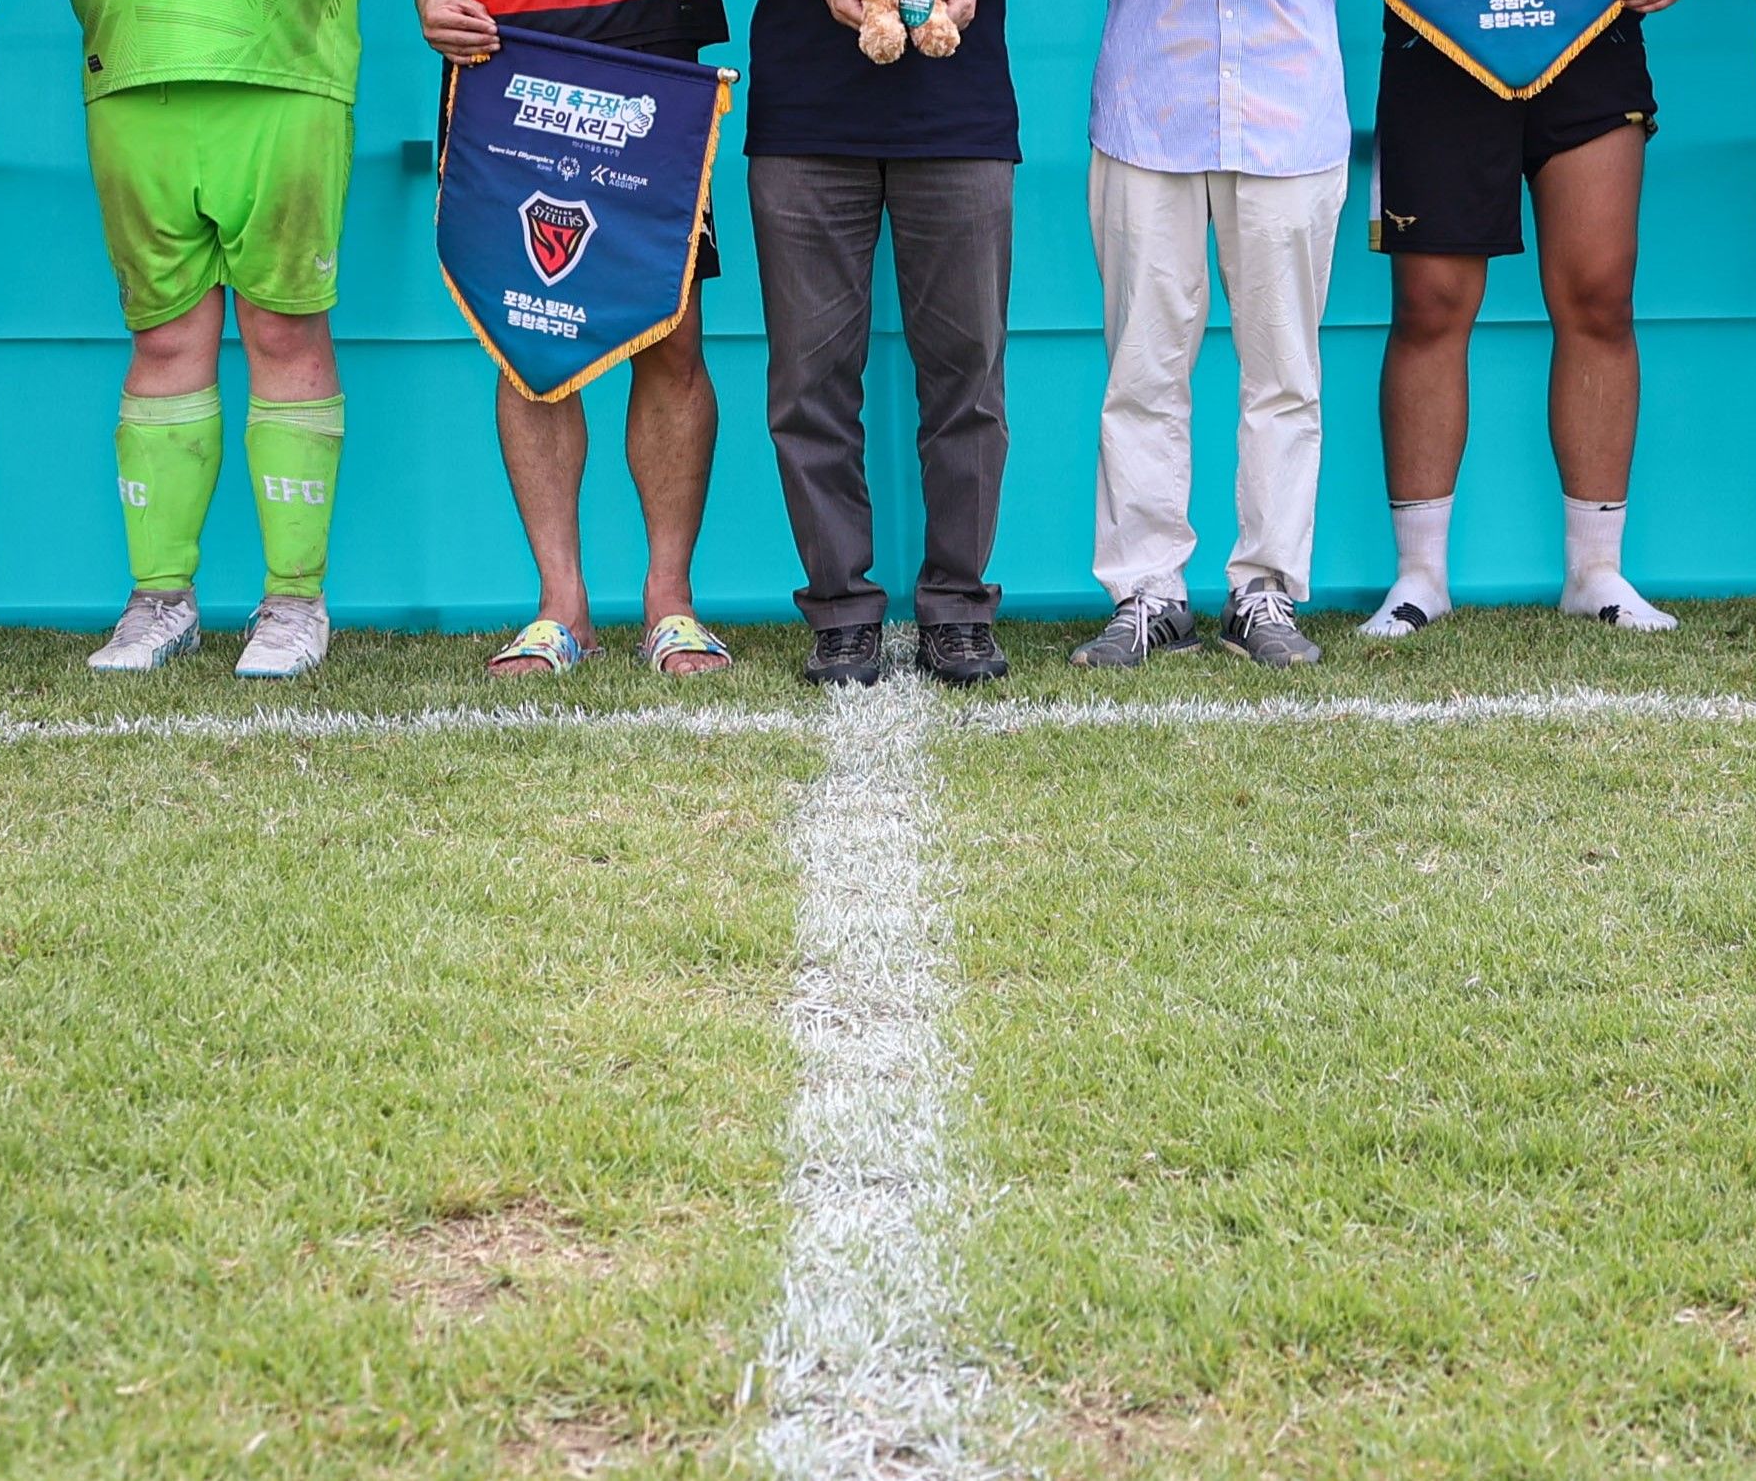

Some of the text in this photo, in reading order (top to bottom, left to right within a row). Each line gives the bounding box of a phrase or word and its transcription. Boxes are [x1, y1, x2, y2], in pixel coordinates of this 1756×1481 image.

[1480, 11, 1555, 28] 통합축구단
[509, 78, 620, 118] 모두의 축구장
[518, 105, 627, 142] 모두의 K리그
[530, 204, 584, 228] STEELERS
[507, 311, 579, 339] 통합축구단
[263, 475, 324, 505] EFC
